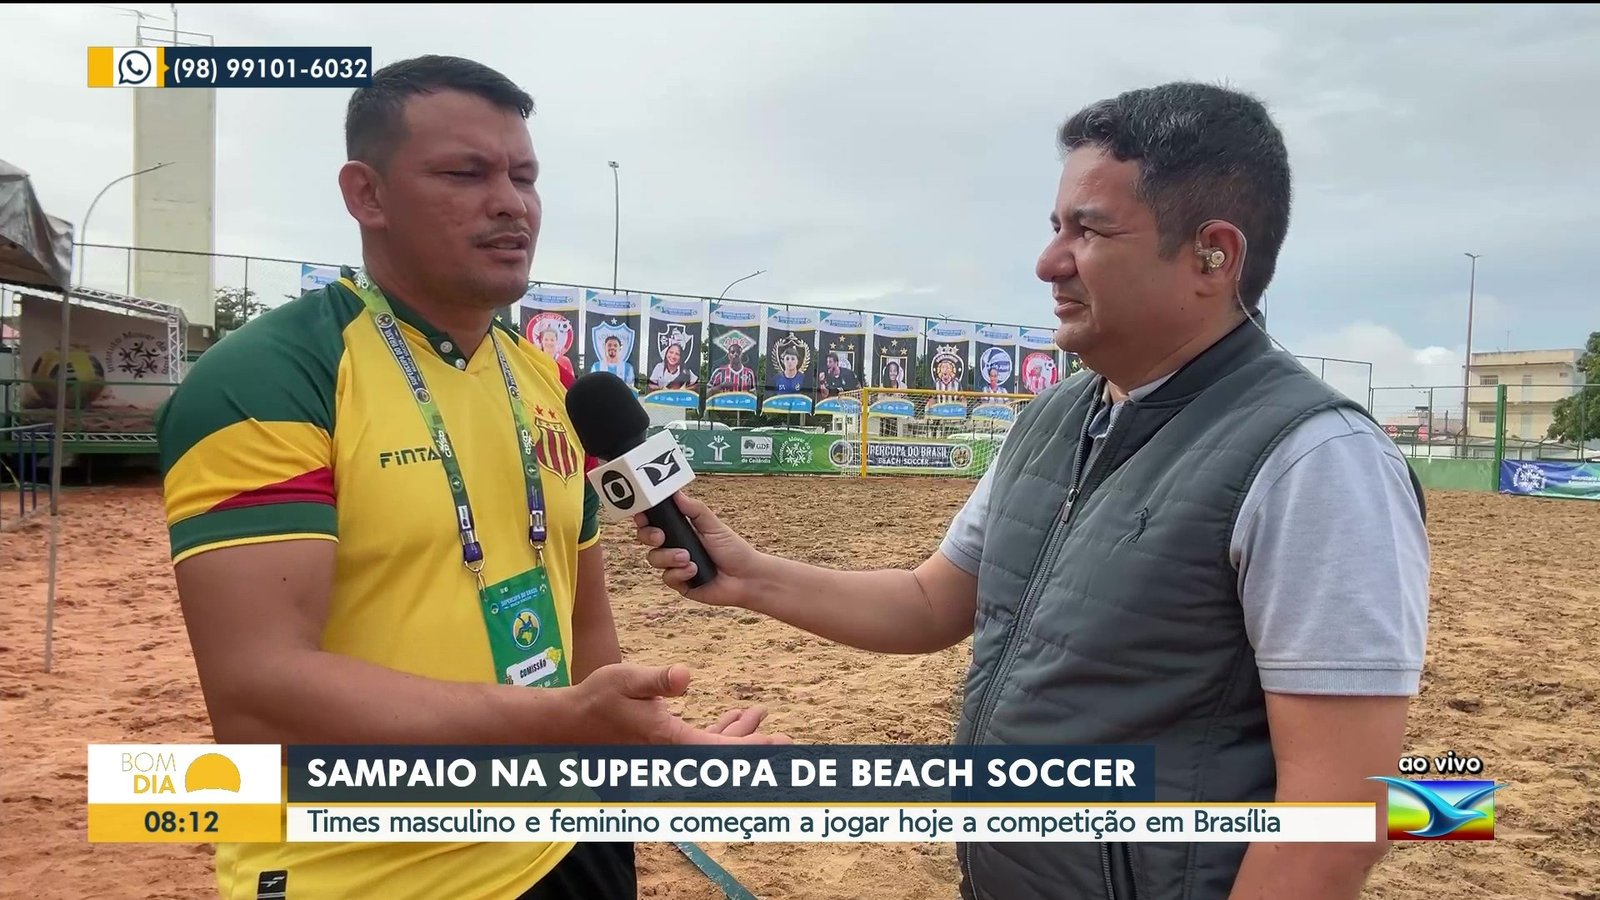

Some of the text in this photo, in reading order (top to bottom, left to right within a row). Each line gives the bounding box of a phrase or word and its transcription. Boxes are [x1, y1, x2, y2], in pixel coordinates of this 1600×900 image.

[866, 445, 948, 458] PERCOPA DO BRASIL
[519, 659, 547, 679] COMISSÃO
